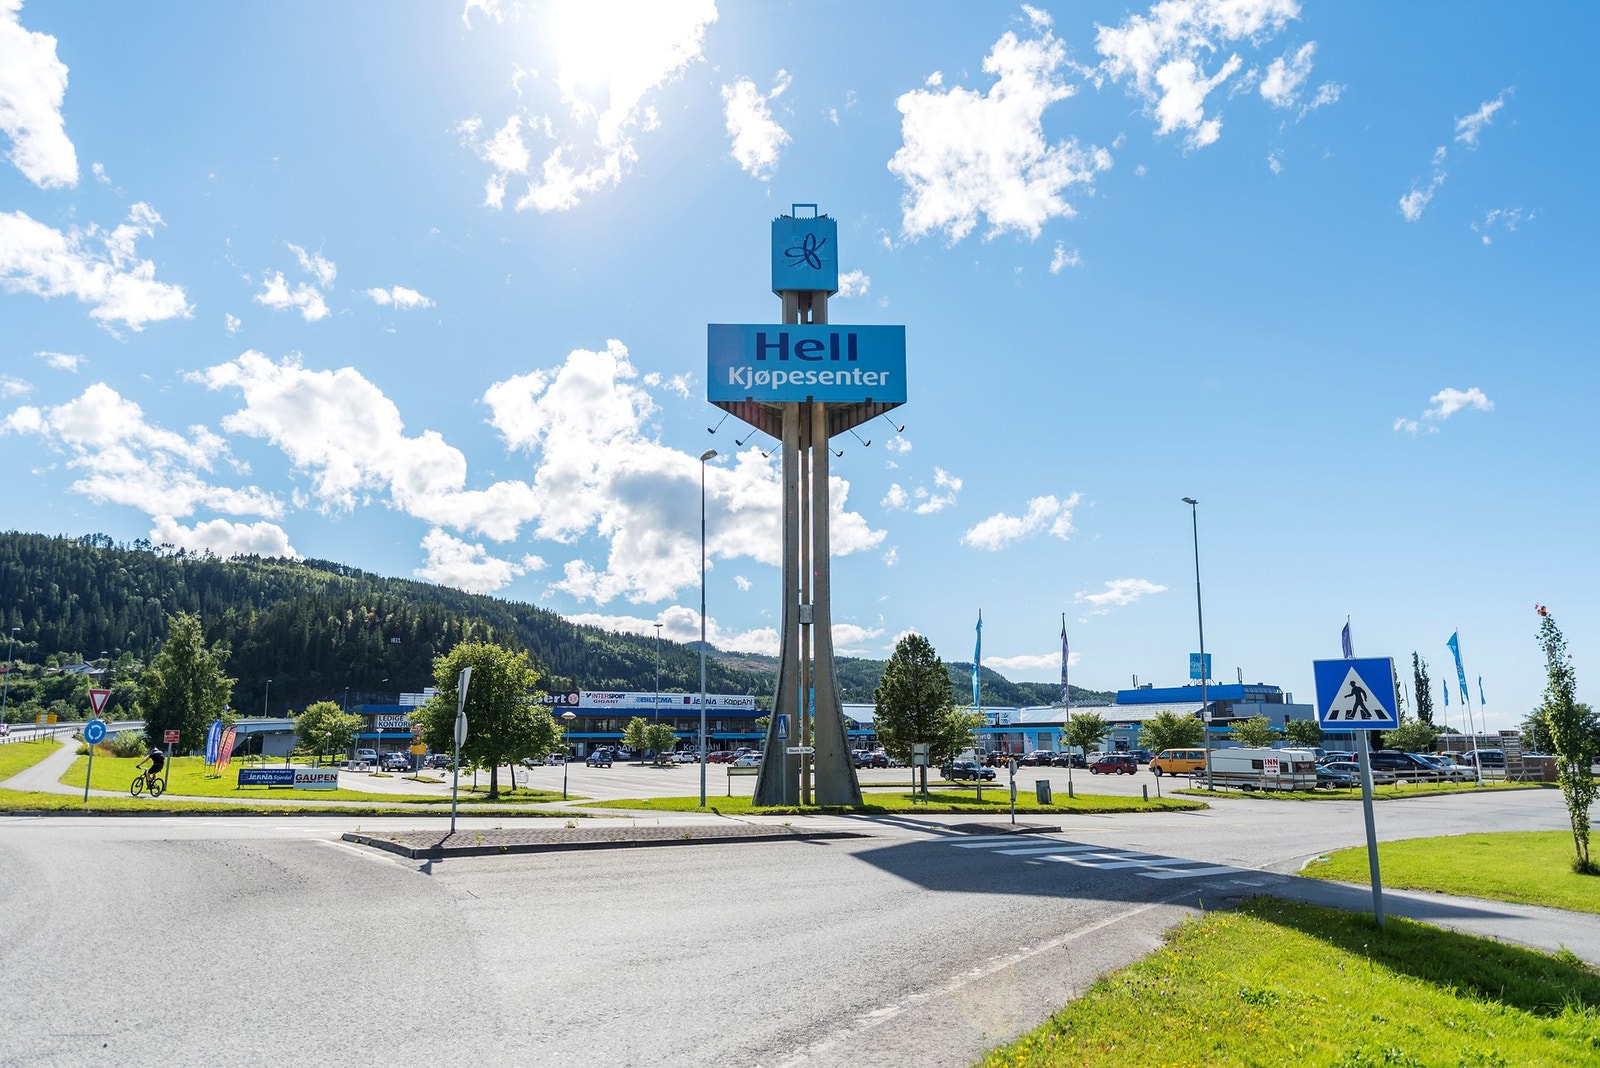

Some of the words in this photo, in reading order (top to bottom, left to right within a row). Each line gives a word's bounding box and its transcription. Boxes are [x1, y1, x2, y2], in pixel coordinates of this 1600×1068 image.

[756, 332, 858, 361] Hell
[728, 366, 890, 390] Kjøpesenter
[723, 697, 753, 706] KappAhl
[683, 743, 721, 752] KapAhl
[295, 773, 338, 781] GAUPEN
